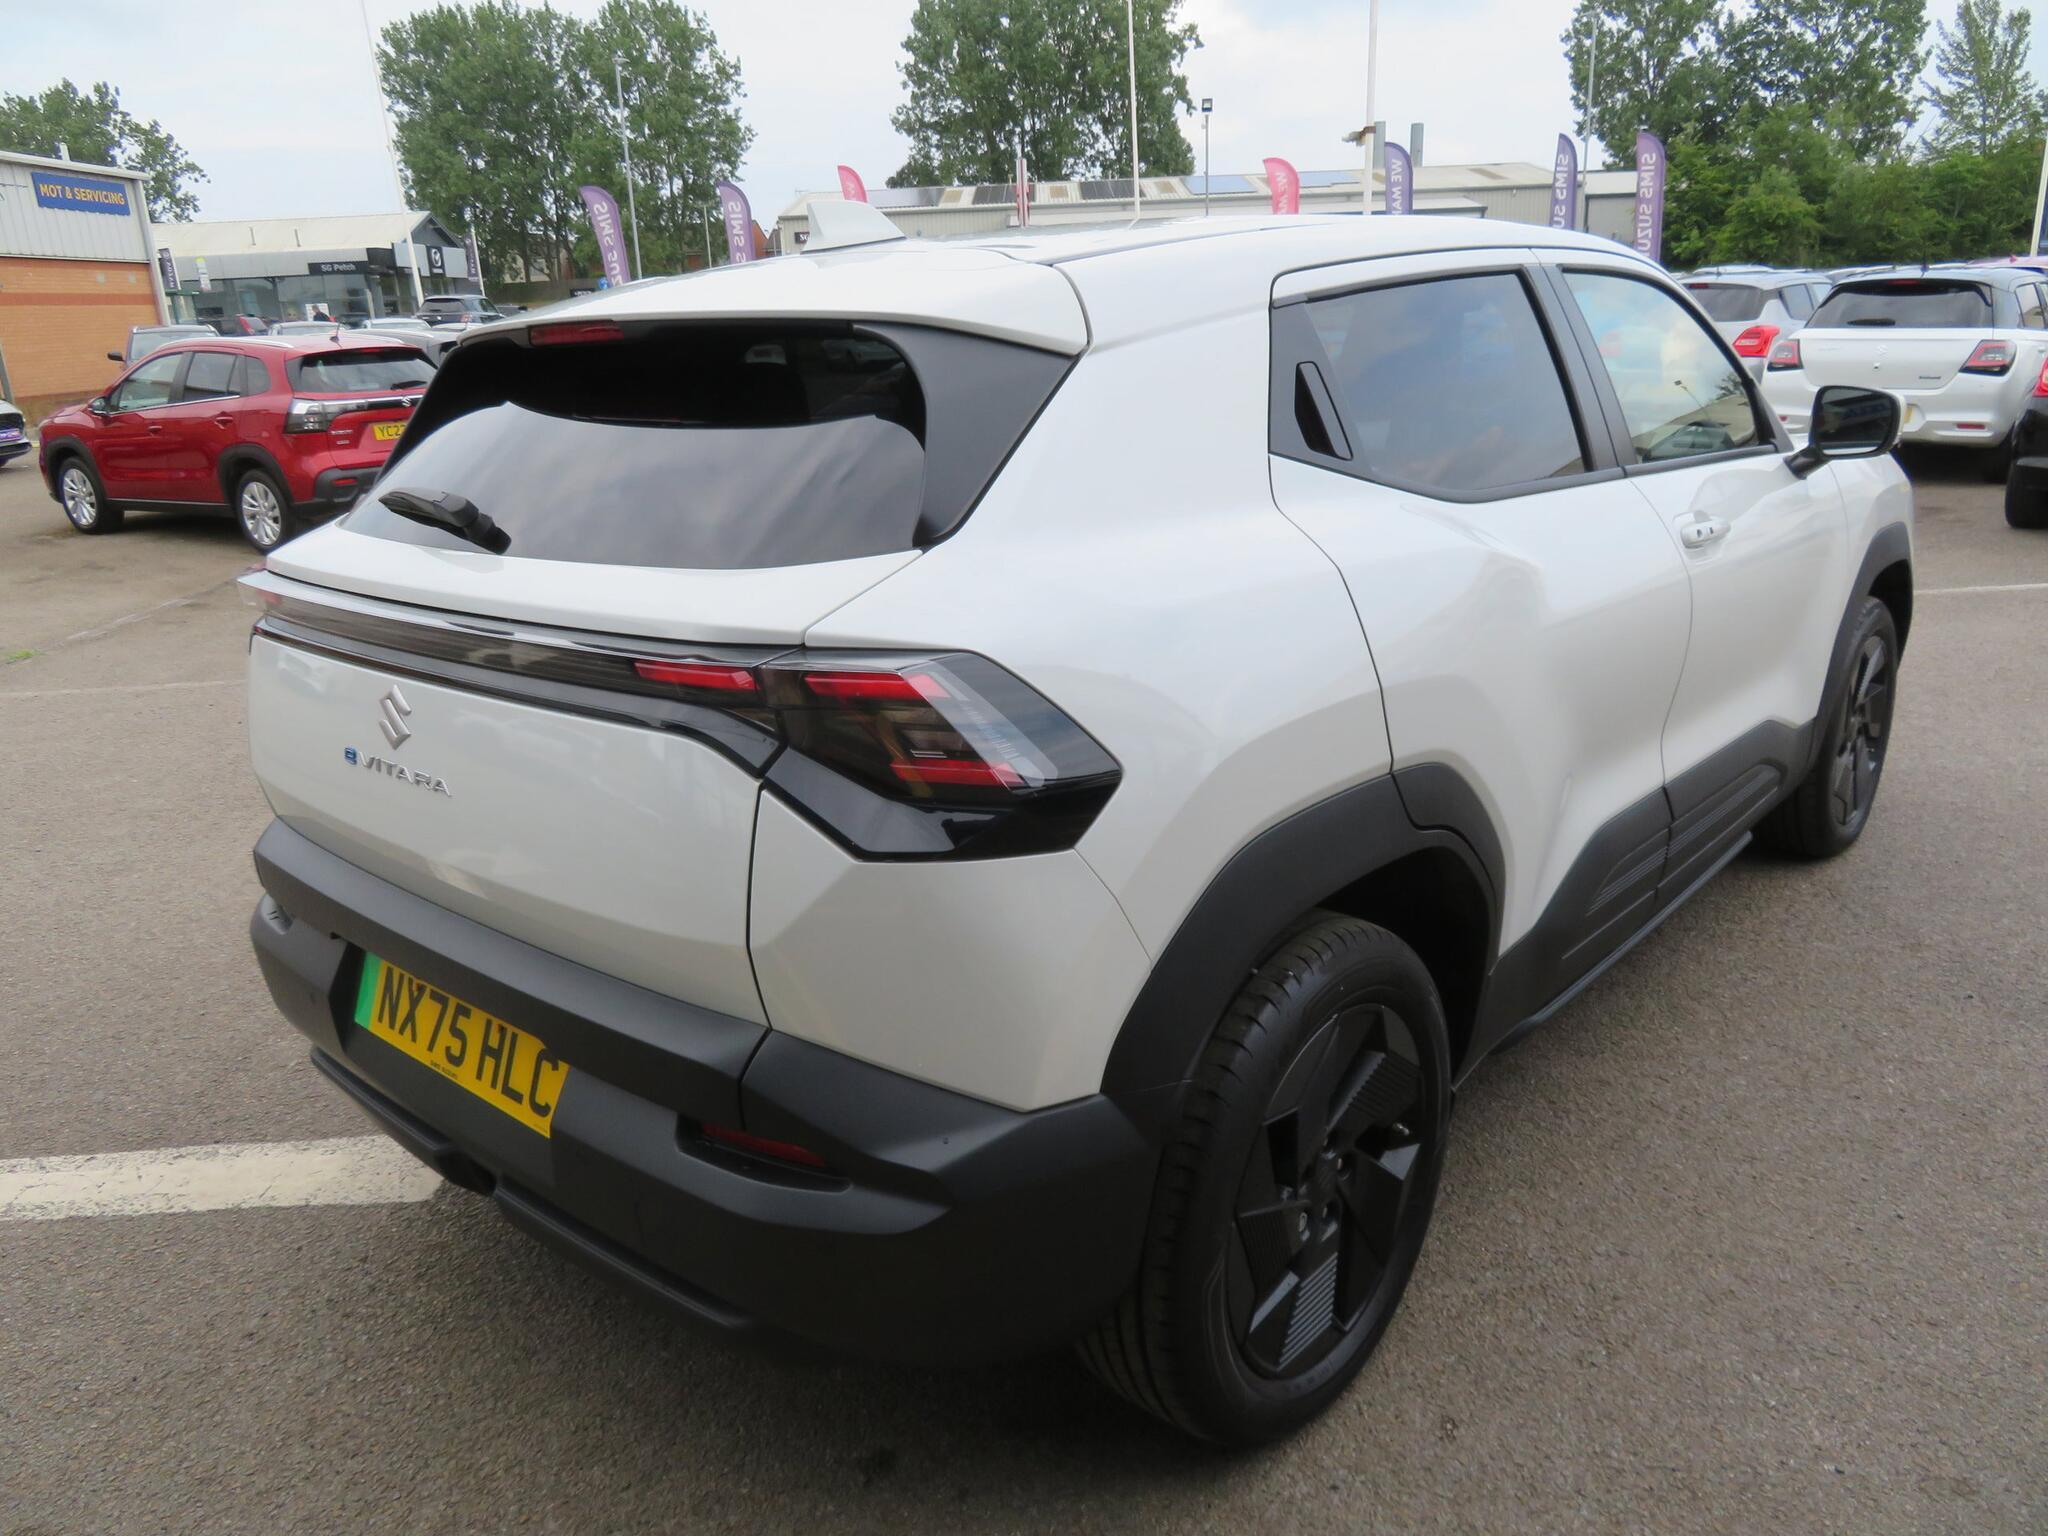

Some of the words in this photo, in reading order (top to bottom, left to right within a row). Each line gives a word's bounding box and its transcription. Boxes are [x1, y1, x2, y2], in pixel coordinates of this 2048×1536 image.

[39, 183, 63, 198] MOT
[65, 186, 72, 200] &
[74, 187, 125, 204] SERVICING
[378, 965, 471, 1068] NX75
[475, 1018, 560, 1118] HLC
